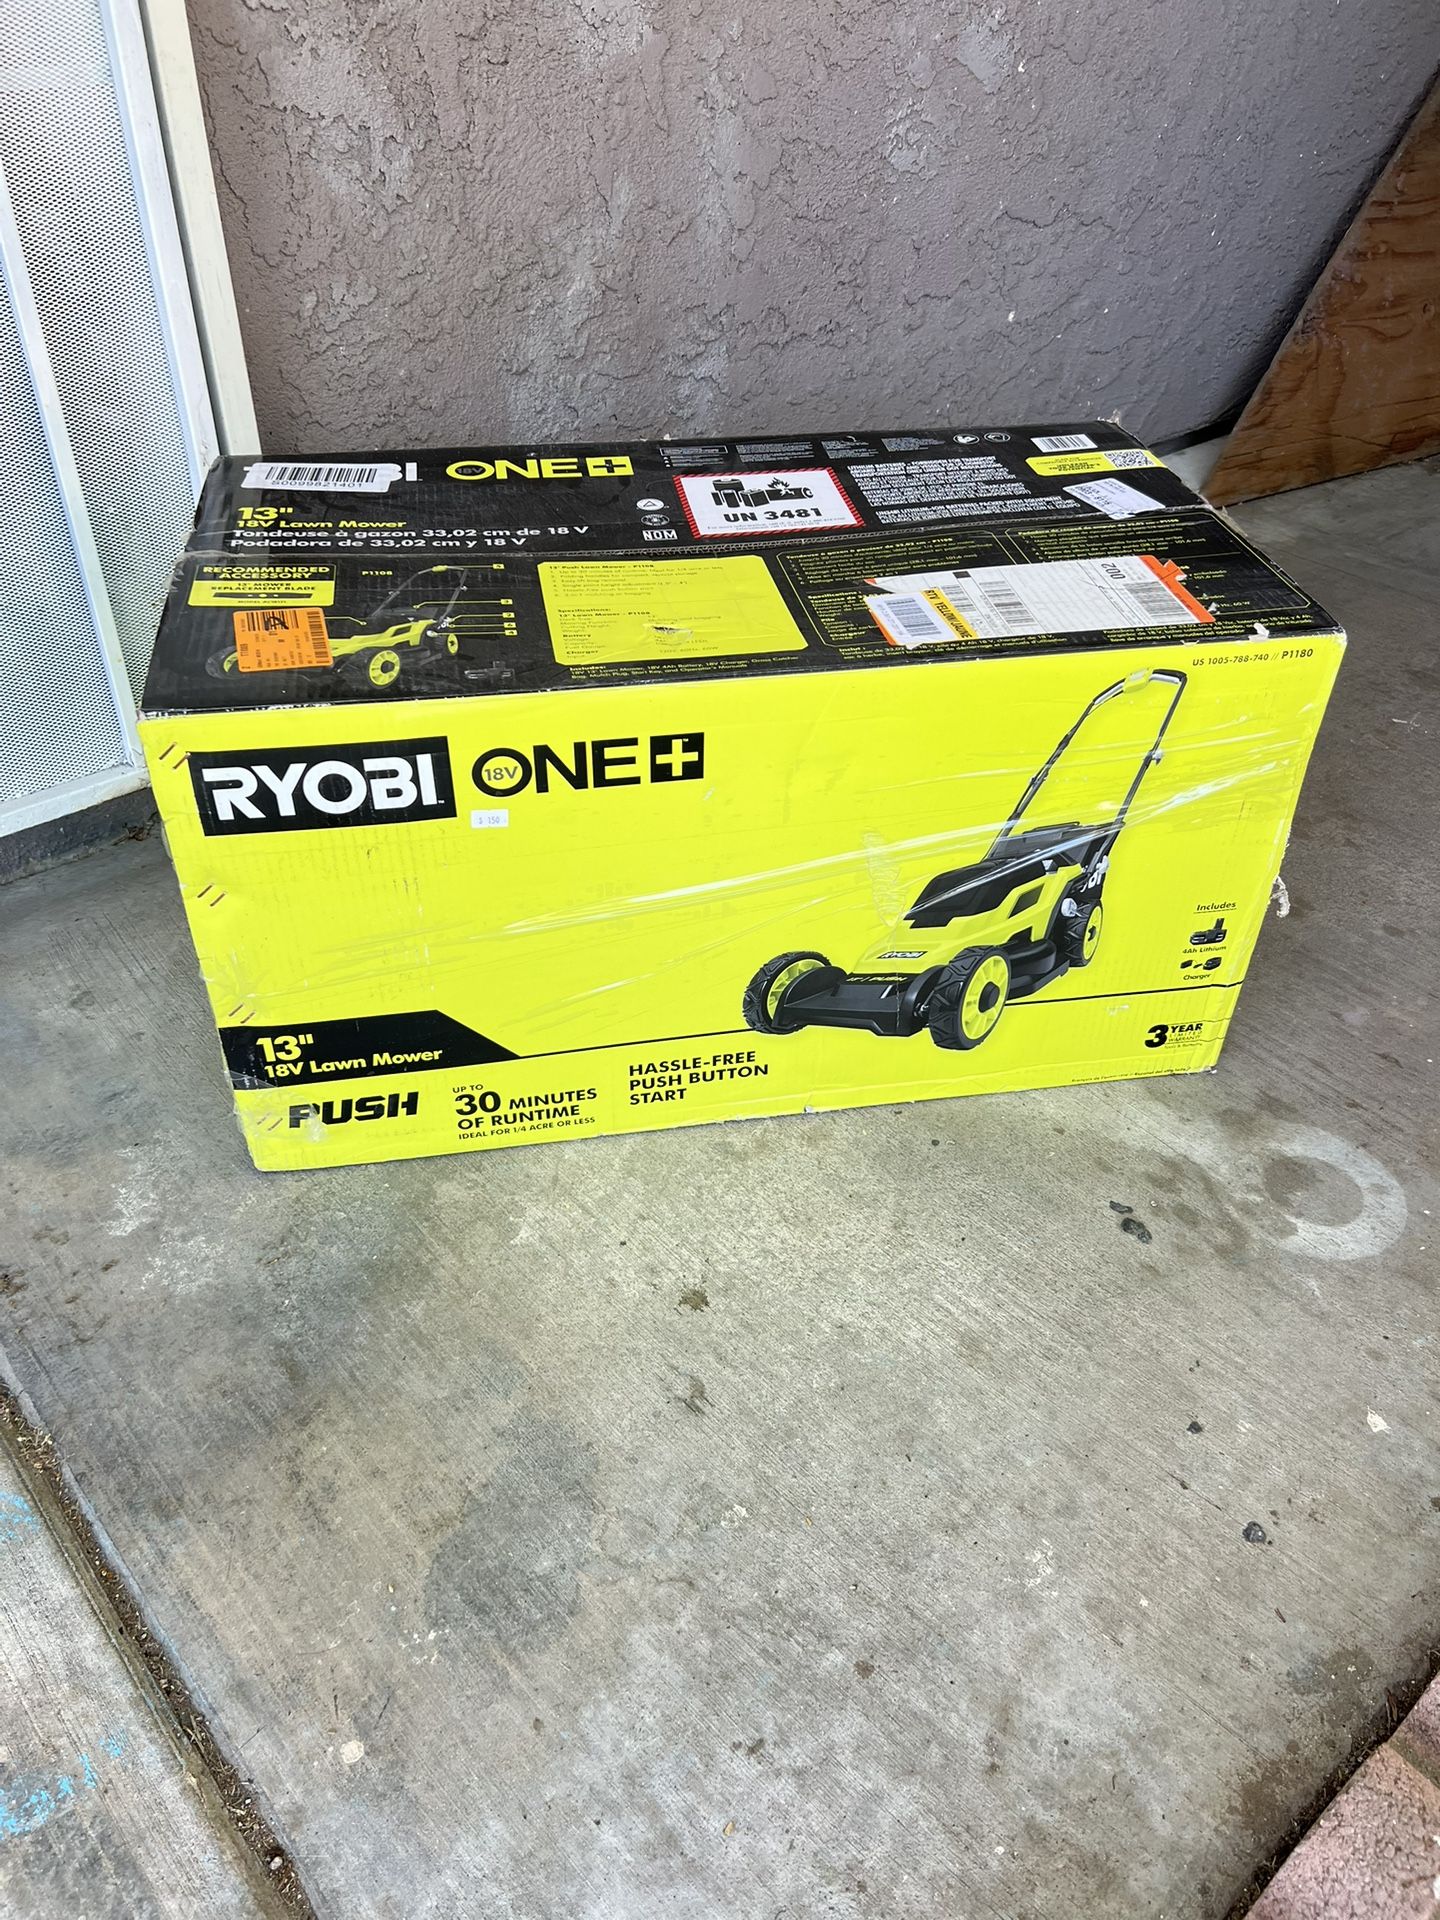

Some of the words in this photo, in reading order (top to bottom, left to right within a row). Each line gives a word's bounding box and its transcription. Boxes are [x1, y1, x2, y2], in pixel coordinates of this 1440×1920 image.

[238, 507, 293, 520] 13"
[723, 512, 757, 522] UN
[763, 508, 822, 520] 3481
[232, 529, 329, 538] Tondeuse
[335, 529, 348, 538] à
[354, 531, 416, 539] gazon
[422, 528, 477, 538] 33,02
[482, 529, 511, 537] cm
[516, 527, 540, 537] de
[547, 527, 569, 535] 18
[573, 526, 589, 534] V
[237, 520, 275, 528] 18V
[280, 520, 333, 528] Lawn
[338, 520, 407, 528] Mower
[230, 539, 332, 547] Podadora
[338, 539, 364, 547] de
[370, 538, 426, 548] 33,02
[432, 539, 461, 547] cm
[466, 539, 479, 548] y
[483, 538, 506, 546] 18
[511, 537, 527, 546] V
[643, 530, 677, 540] NOM
[1192, 658, 1205, 666] US
[1208, 653, 1269, 665] 1005-788-740
[1281, 648, 1313, 660] P1180
[484, 764, 520, 783] 18V
[201, 753, 438, 821] RYOBI
[1196, 901, 1236, 912] Includes
[1200, 945, 1227, 953] Lithium
[1144, 1024, 1169, 1048] 3
[1171, 1023, 1203, 1033] YEAR
[256, 1033, 314, 1063] 13"
[264, 1061, 304, 1079] 18V
[310, 1058, 366, 1074] Lawn
[372, 1049, 443, 1067] Mower
[629, 1050, 756, 1077] HASSLE-FREE
[629, 1076, 682, 1091] PUSH
[689, 1063, 769, 1084] BUTTON
[452, 1085, 467, 1094] UP
[469, 1084, 484, 1092] TO
[629, 1088, 687, 1105] START
[289, 1091, 419, 1129] PUSH
[454, 1090, 501, 1116] 30
[509, 1087, 598, 1110] MINUTES
[457, 1117, 484, 1130] OF
[491, 1104, 580, 1127] RUNTIME
[458, 1131, 488, 1140] IDEAL
[490, 1128, 510, 1136] FOR
[513, 1125, 527, 1134] 1/4
[529, 1122, 554, 1131] ACRE
[557, 1120, 571, 1128] OR
[574, 1117, 596, 1126] LESS
